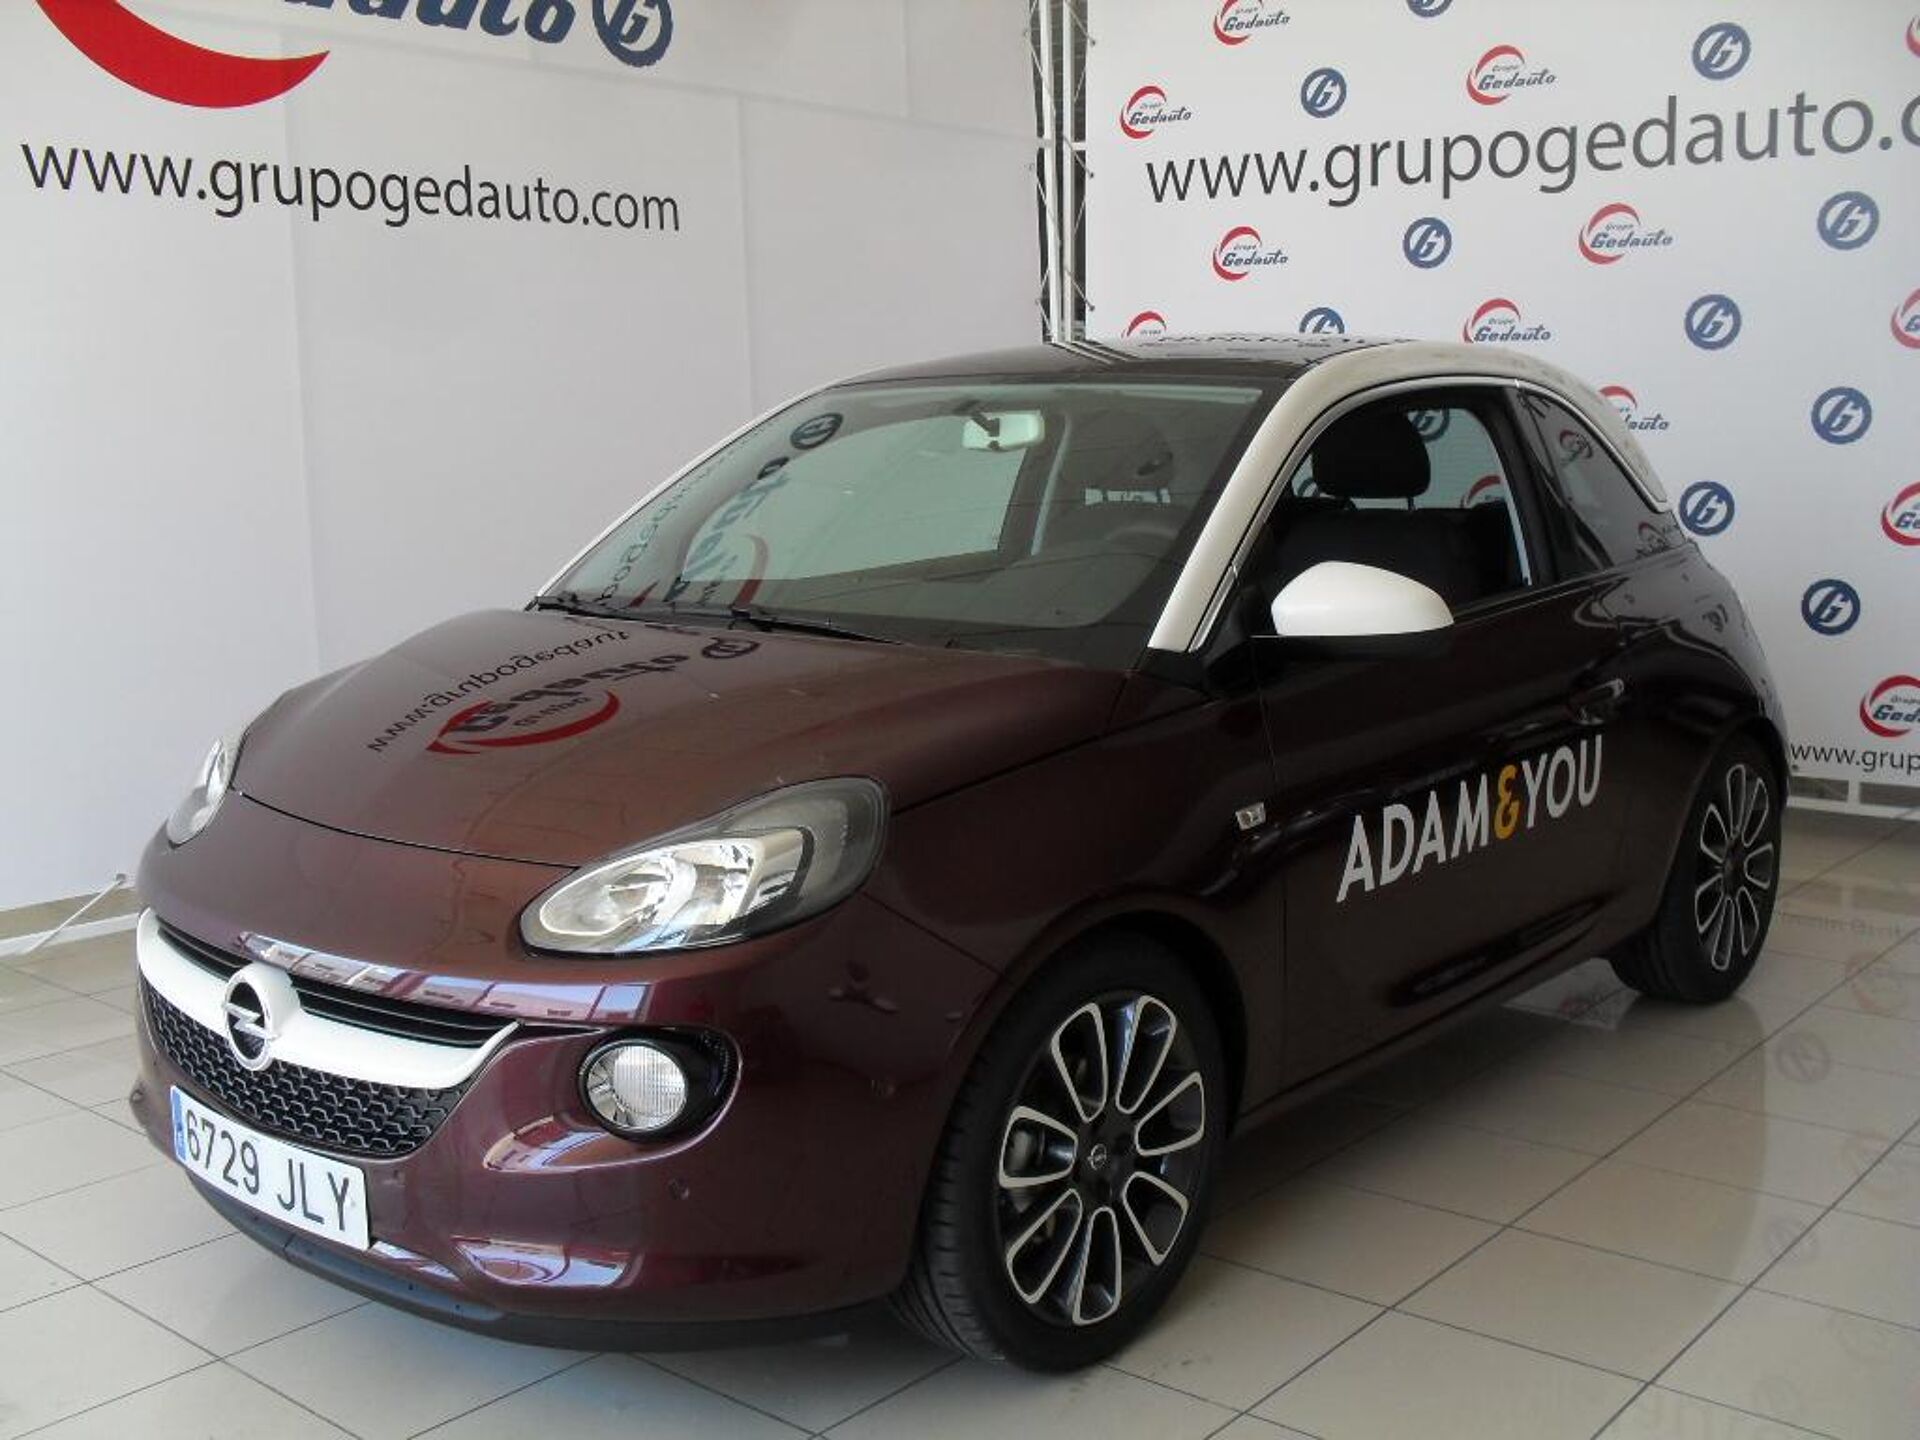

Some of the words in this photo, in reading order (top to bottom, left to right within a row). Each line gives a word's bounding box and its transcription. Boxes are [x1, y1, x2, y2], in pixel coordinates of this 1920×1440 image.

[1222, 10, 1290, 32] Gedauto
[1477, 68, 1555, 90] Gedauto
[1128, 106, 1192, 125] Gedauto
[21, 143, 680, 231] www.grupogedauto.com
[1590, 229, 1674, 248] Gedauto
[1222, 249, 1289, 267] Gedauto
[1473, 324, 1551, 342] Gedauto
[186, 1109, 260, 1195] 6729
[277, 1158, 349, 1231] JLY
